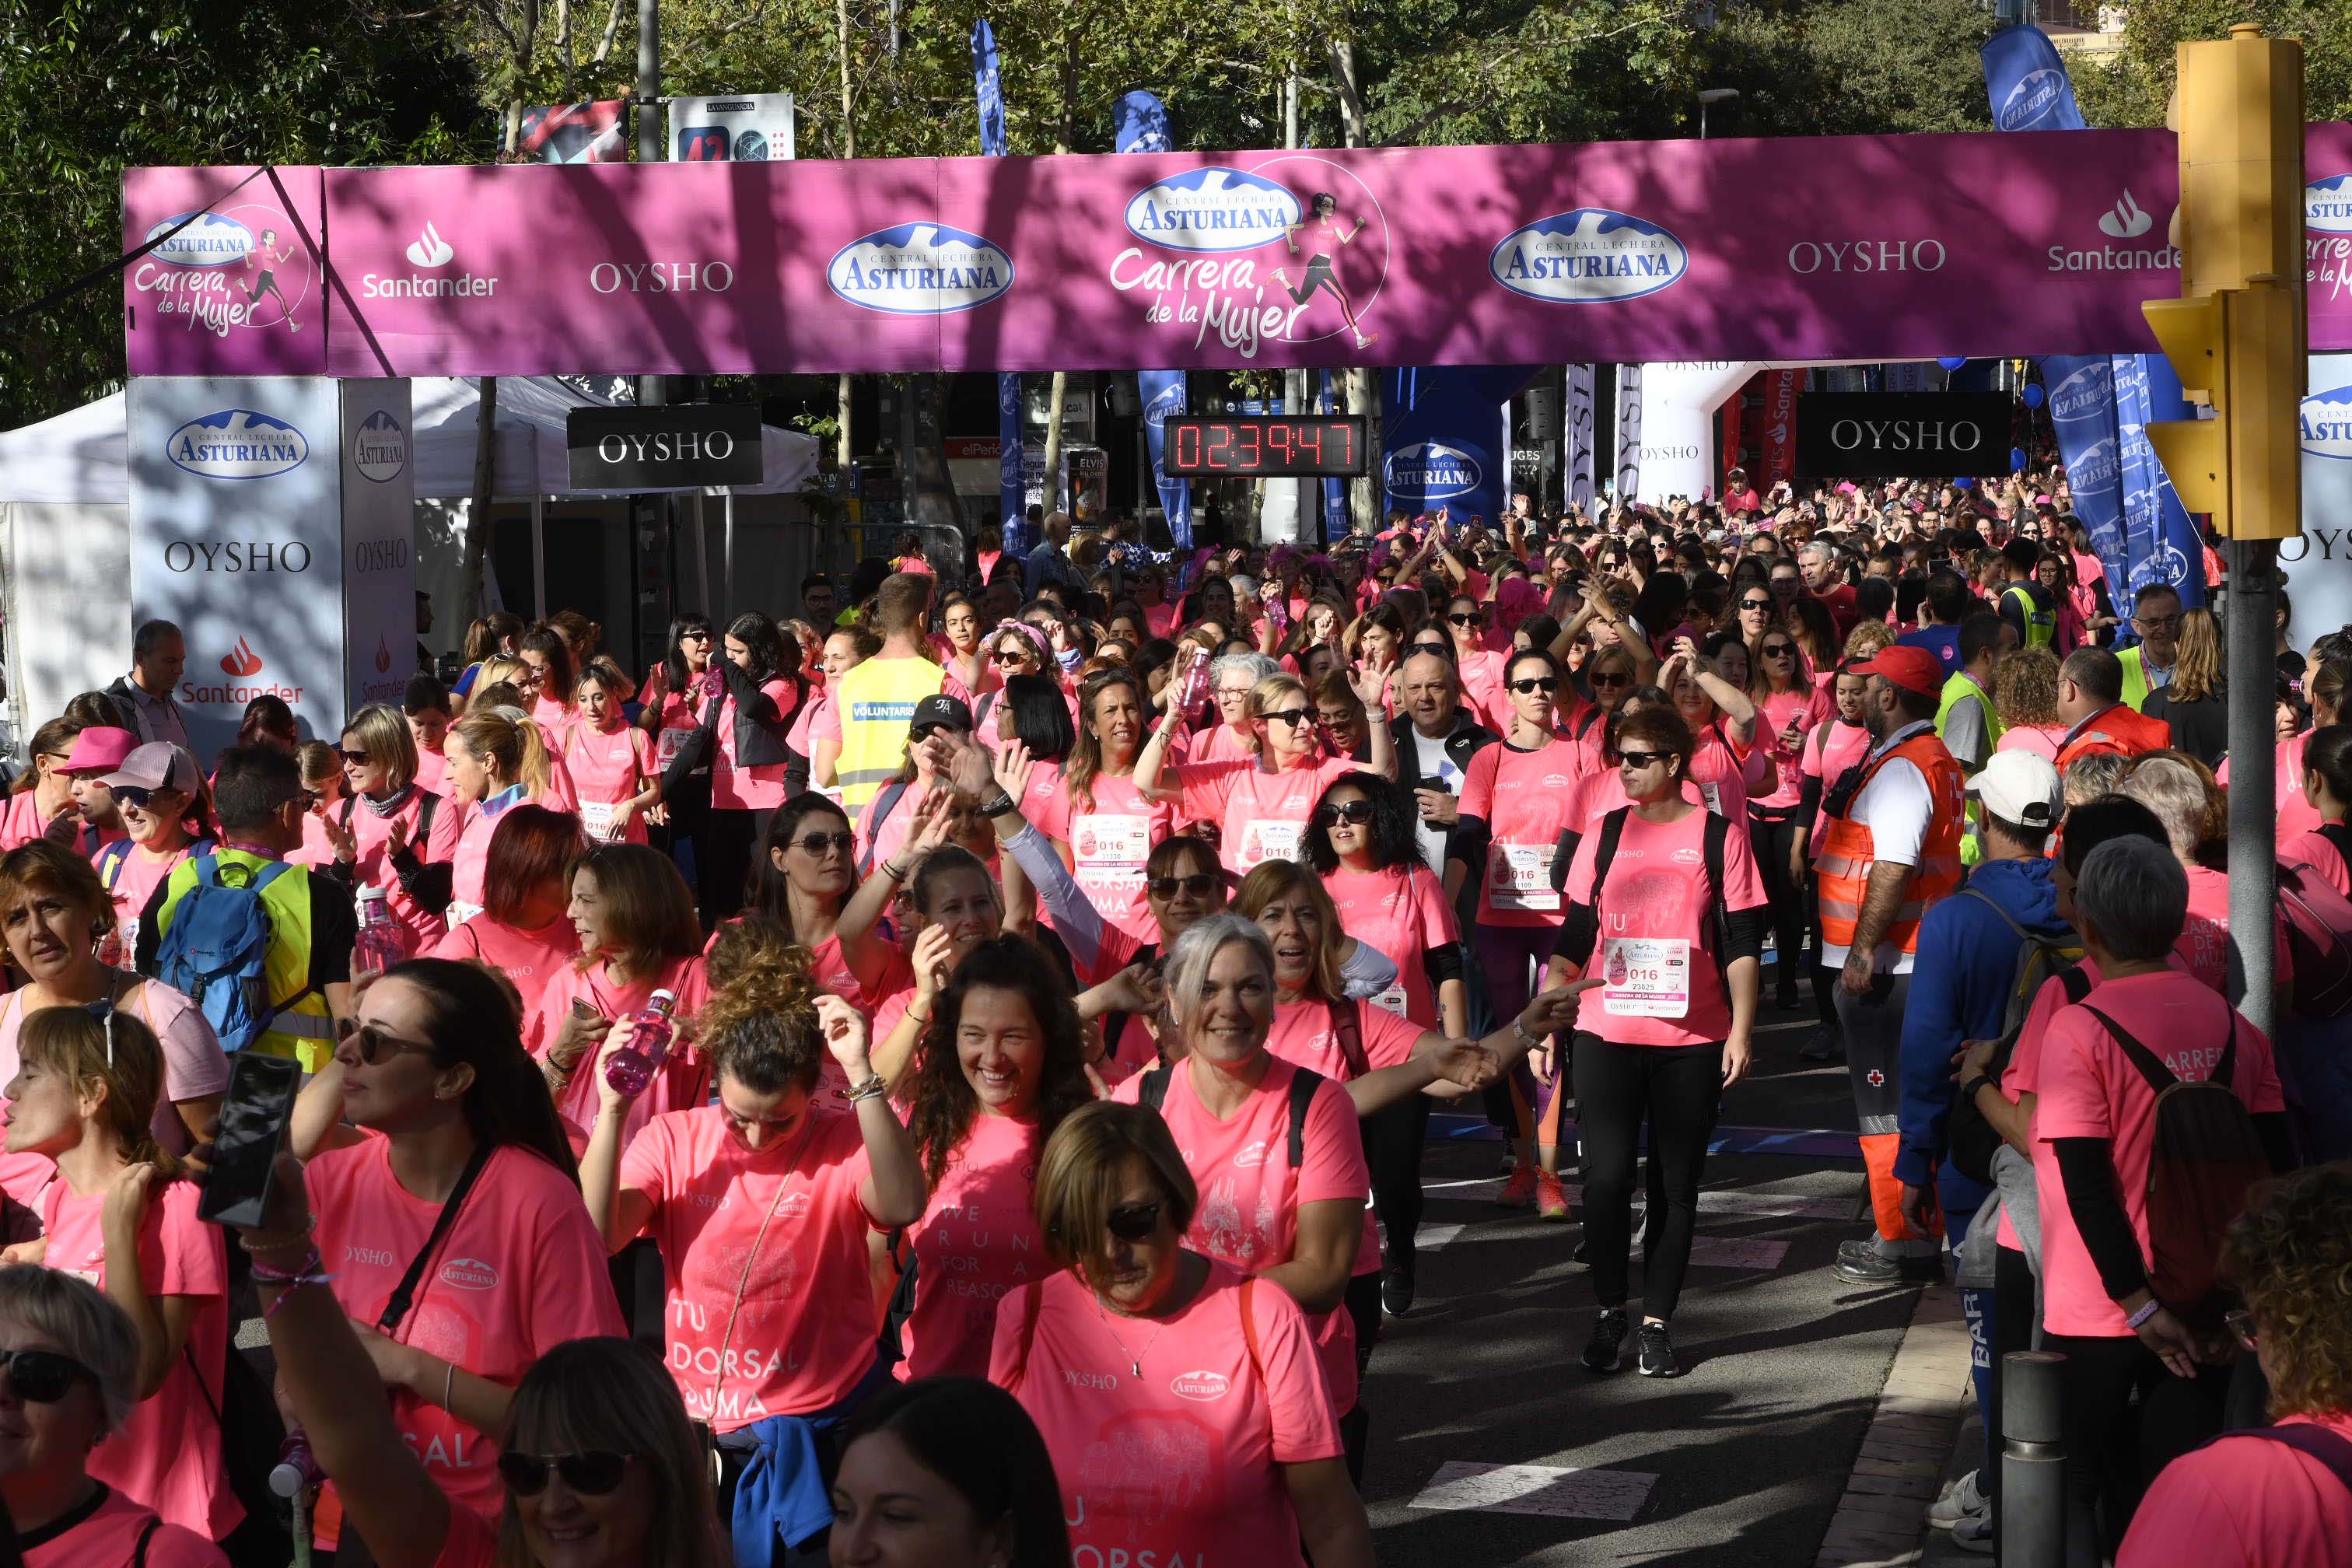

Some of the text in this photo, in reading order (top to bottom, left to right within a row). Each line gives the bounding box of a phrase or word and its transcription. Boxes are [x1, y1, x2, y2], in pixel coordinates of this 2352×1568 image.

[1166, 194, 1283, 206] CENTRAL LECHERA
[1139, 198, 1289, 232] ASTURIANA
[153, 231, 247, 253] ASTURIANA
[1535, 239, 1665, 252] CENTRAL LECHERA
[870, 252, 994, 264] CENTRAL LECHERA
[1504, 245, 1671, 281] ASTURIANA
[1788, 239, 1946, 274] OYSHO
[2048, 244, 2182, 272] Santande
[134, 263, 228, 293] Carrera
[590, 261, 733, 293] OYSHO
[842, 256, 1000, 291] ASTURIANA
[1110, 247, 1258, 292] Carrera
[362, 272, 499, 298] Santander
[157, 289, 261, 337] de la Mujer
[1146, 285, 1310, 359] de la Mujer
[597, 430, 735, 464] OYSHO
[1830, 419, 1982, 451] OYSHO
[178, 438, 299, 463] ASTURIANA
[358, 438, 404, 466] ASTURIANA
[1080, 458, 1105, 468] ELVIS
[1639, 446, 1699, 461] OYSHO
[1388, 467, 1475, 487] ASTURIANA
[164, 540, 312, 575] OYSHO
[355, 537, 408, 574] OYSHO
[181, 682, 303, 705] Santander
[362, 679, 405, 702] Santander
[853, 705, 916, 717] VOLUNTARIS
[1099, 841, 1124, 851] 016
[1265, 847, 1291, 857] 016
[1511, 870, 1535, 880] 016
[1629, 969, 1658, 981] 016
[940, 1204, 980, 1222] WE
[941, 1256, 1028, 1277] FOR A
[947, 1282, 1008, 1302] REASO
[673, 1298, 707, 1332] TU
[674, 1341, 800, 1377] DORSAL
[1175, 1381, 1227, 1393] ASTURIANA
